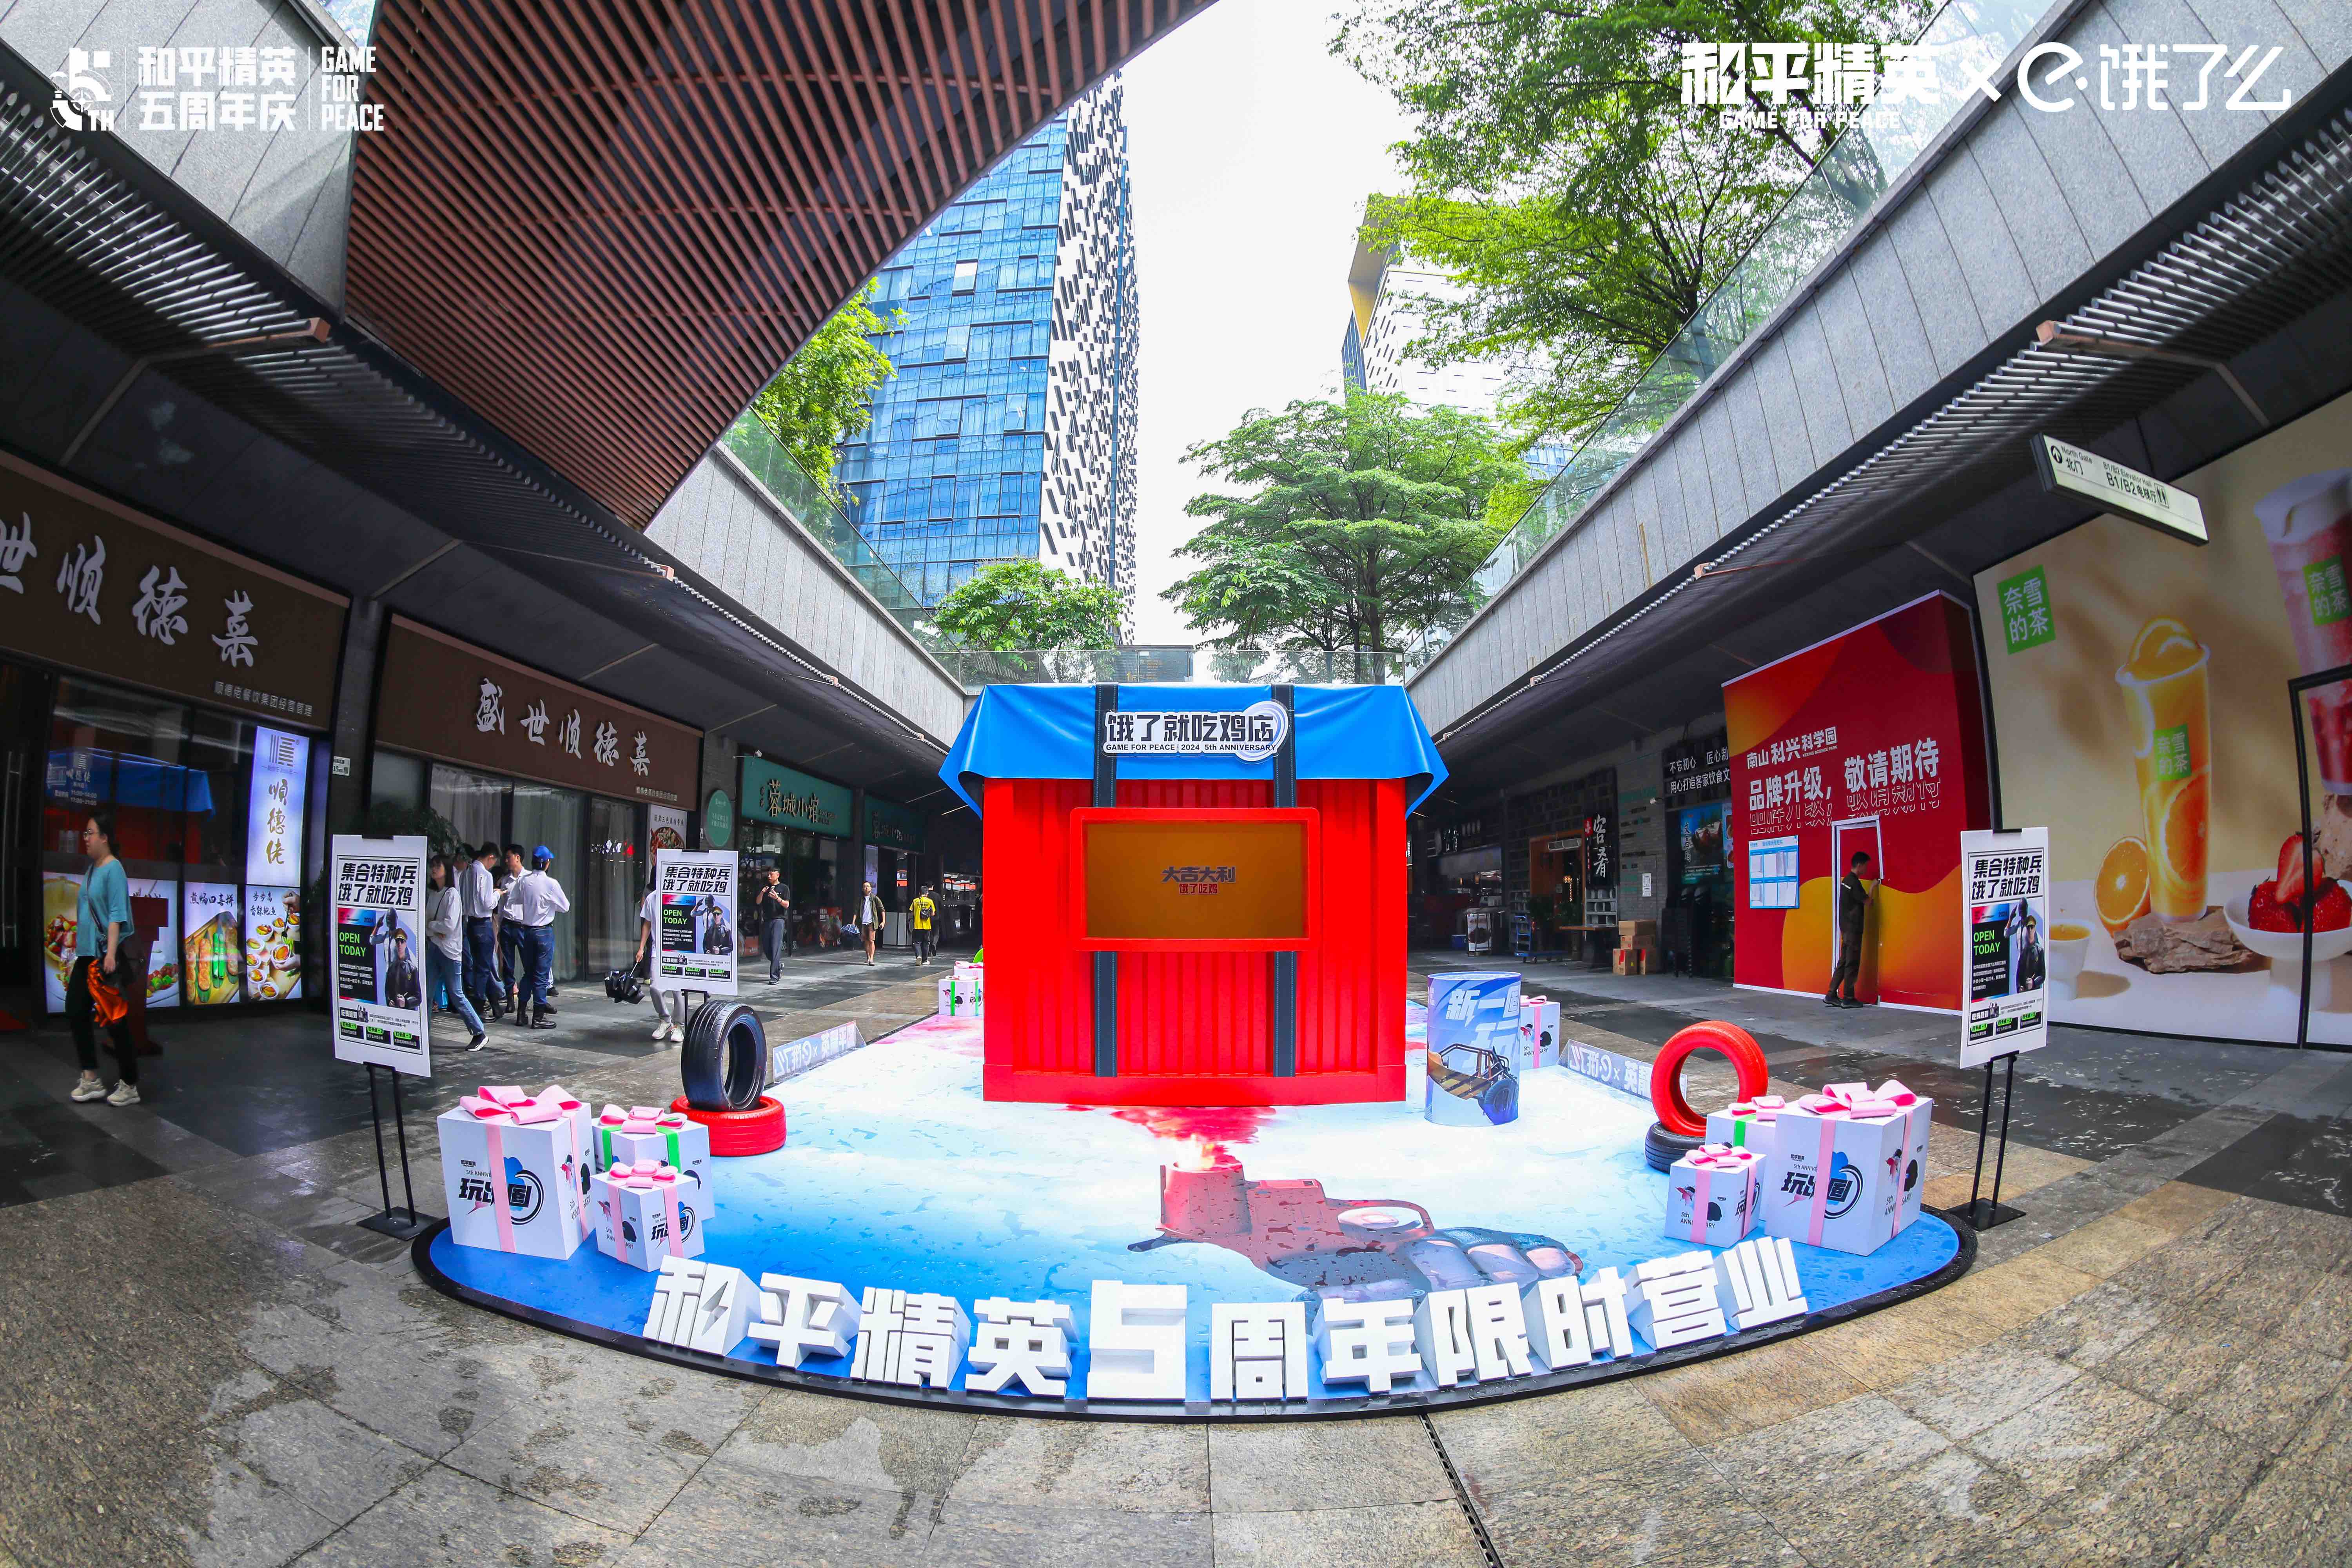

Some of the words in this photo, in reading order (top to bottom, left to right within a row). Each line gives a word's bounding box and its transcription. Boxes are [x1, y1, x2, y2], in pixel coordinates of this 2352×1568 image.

[2061, 445, 2078, 458] North
[2065, 457, 2083, 475] 北门
[2120, 468, 2142, 483] Elevator
[2107, 472, 2156, 503] B1/B2电梯厅
[2308, 563, 2341, 594] 奈雪
[2004, 577, 2043, 615] 奈雪
[2314, 588, 2347, 617] 的茶
[2009, 608, 2049, 643] 的茶
[476, 678, 651, 777] 盛世顺德菜
[1108, 714, 1273, 742] 饿了就吃鸡店
[1670, 756, 1696, 775] 不忘初心
[1671, 768, 1731, 794] 用心打造客家饮食文
[767, 779, 819, 823] 蓉城小馆
[341, 862, 417, 885] 集合特种兵
[664, 866, 731, 880] 集合特种兵
[1161, 866, 1236, 883] 大吉大利
[1973, 855, 2042, 878] 集合特种兵
[338, 883, 413, 906] 饿了就吃鸡
[662, 879, 727, 893] 饿了就吃鸡
[1179, 884, 1219, 895] 饿了吃鸡
[1971, 875, 2040, 900] 饿了就吃鸡
[253, 891, 272, 903] 步步高
[339, 932, 360, 943] OPEN
[1973, 930, 1994, 942] OPEN
[339, 945, 366, 957] TODAY
[1973, 942, 2001, 956] TODAY
[1524, 1048, 1548, 1056] ANNIVSARY
[1681, 1218, 1715, 1229] ANNIARY
[642, 1236, 1809, 1400] 和平精英5周年限时营业
